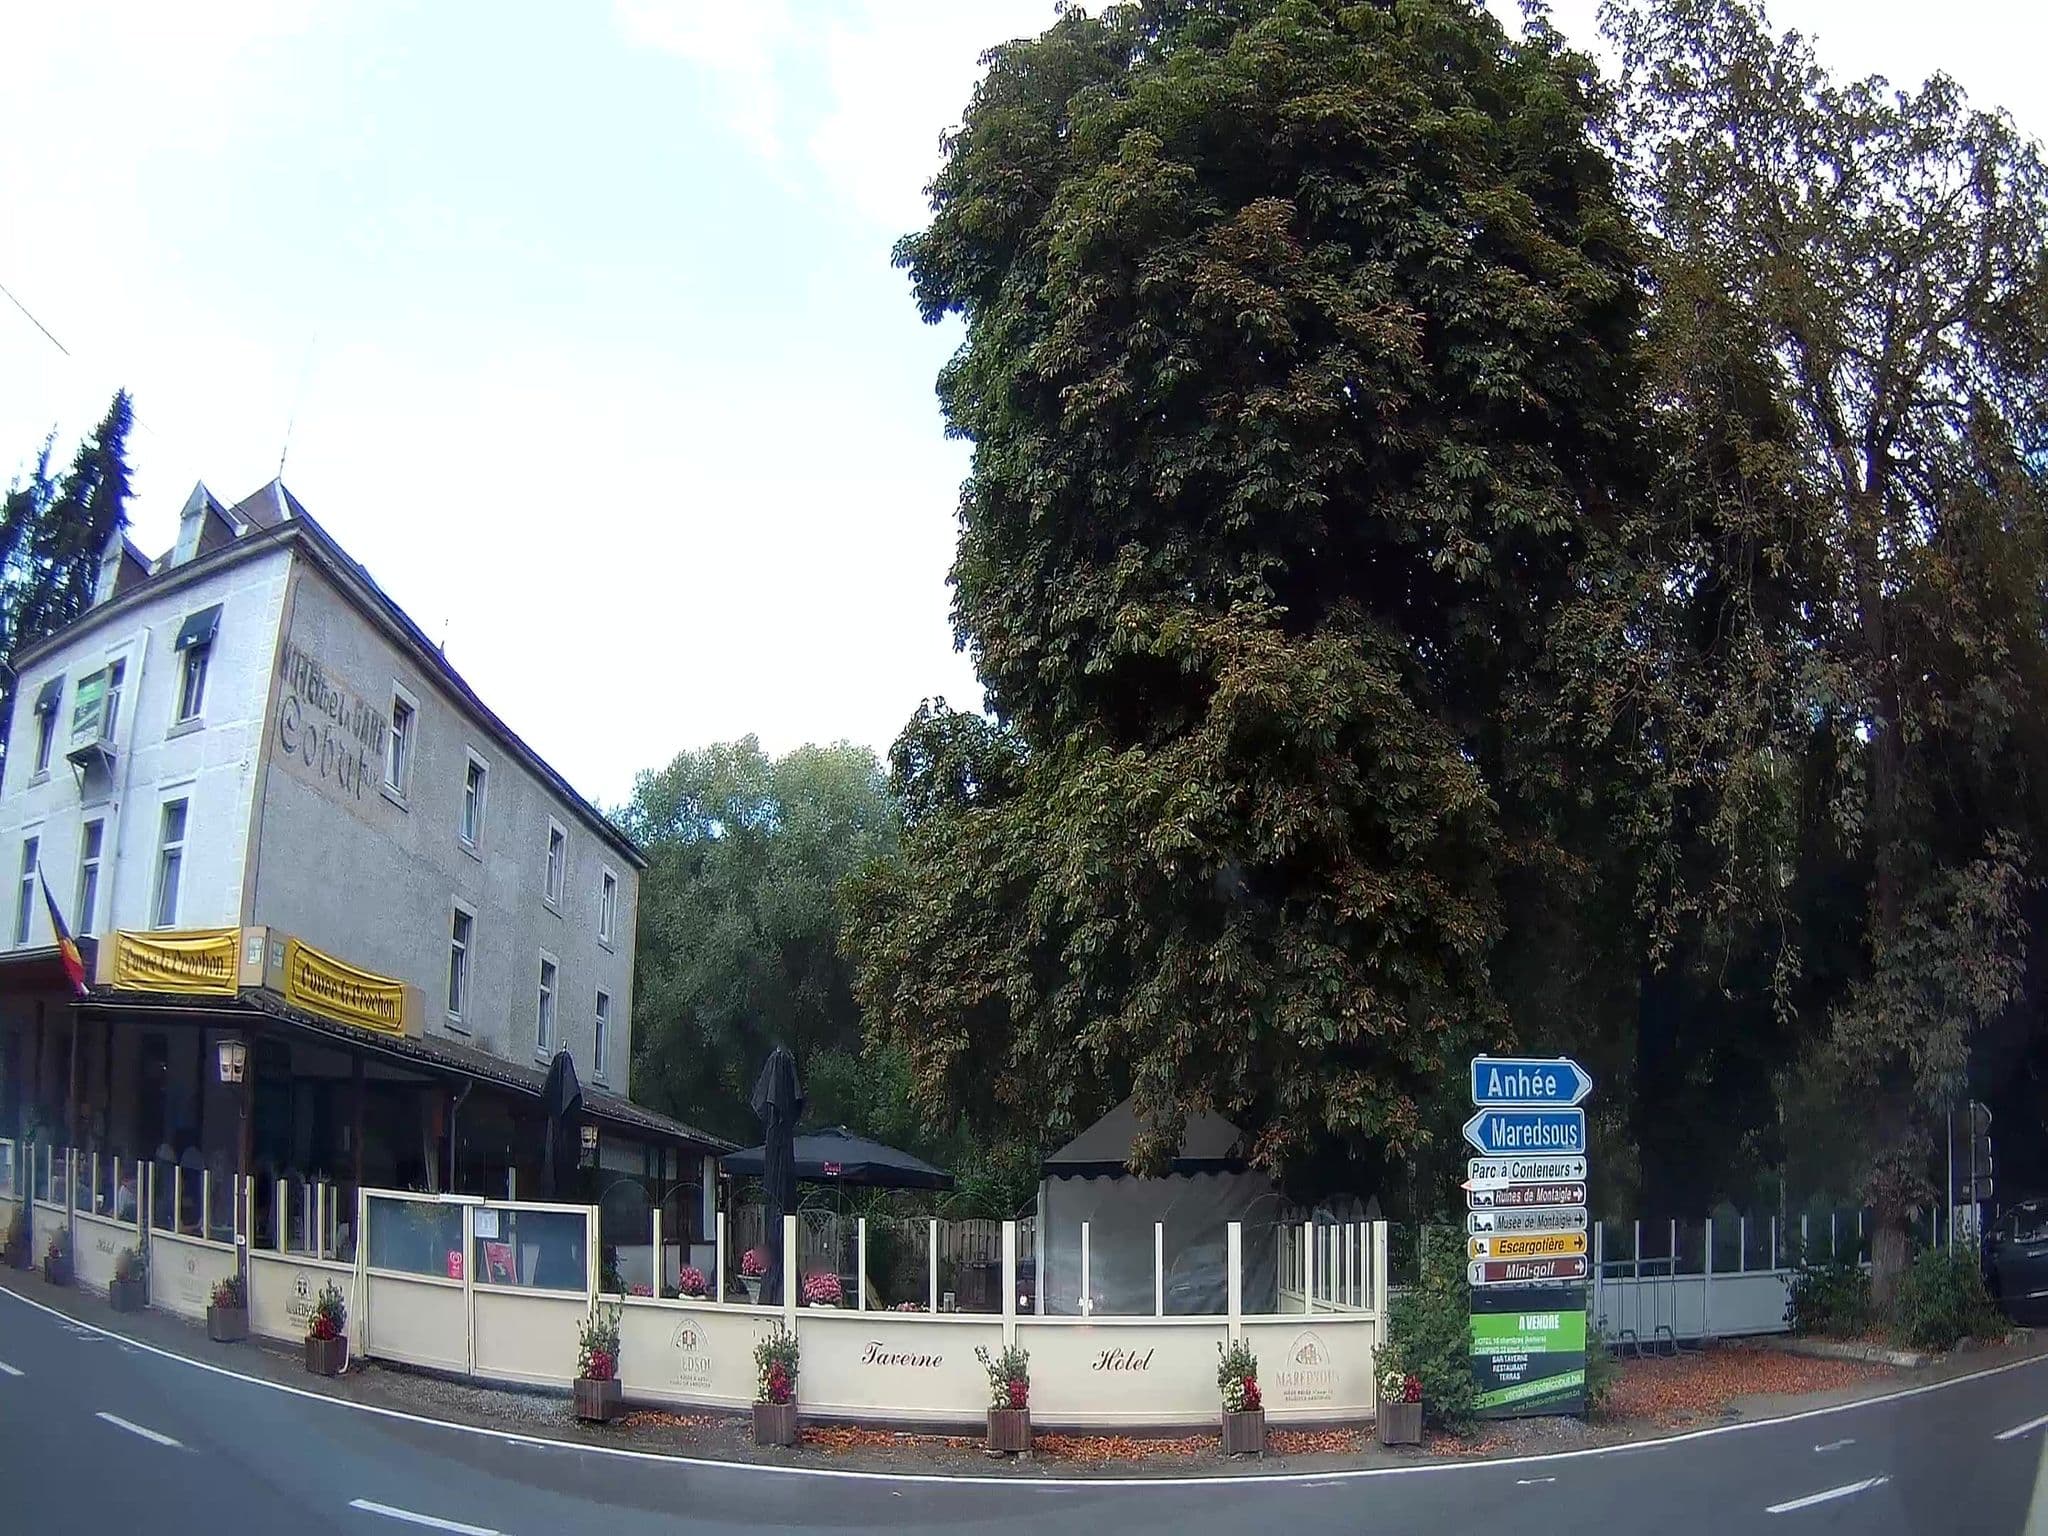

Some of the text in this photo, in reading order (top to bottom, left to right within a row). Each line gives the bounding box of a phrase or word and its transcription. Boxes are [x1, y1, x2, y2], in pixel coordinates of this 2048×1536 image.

[352, 983, 395, 1020] Crochon
[1488, 1067, 1557, 1097] Anhée
[1492, 1118, 1577, 1147] Maredsous
[1472, 1161, 1571, 1179] Parc à Conteneurs
[1495, 1187, 1572, 1204] Ruines de Montaigle
[1524, 1213, 1534, 1228] de
[1537, 1211, 1572, 1229] Montaigle
[1499, 1237, 1565, 1255] Escargotière
[1505, 1261, 1555, 1281] Mini-golf
[1519, 1314, 1560, 1329] A VENDRE
[861, 1341, 943, 1368] Taverne
[1092, 1347, 1154, 1371] Hôtel
[1505, 1354, 1528, 1363] TAVERNE
[1492, 1363, 1527, 1373] RESTAURANT
